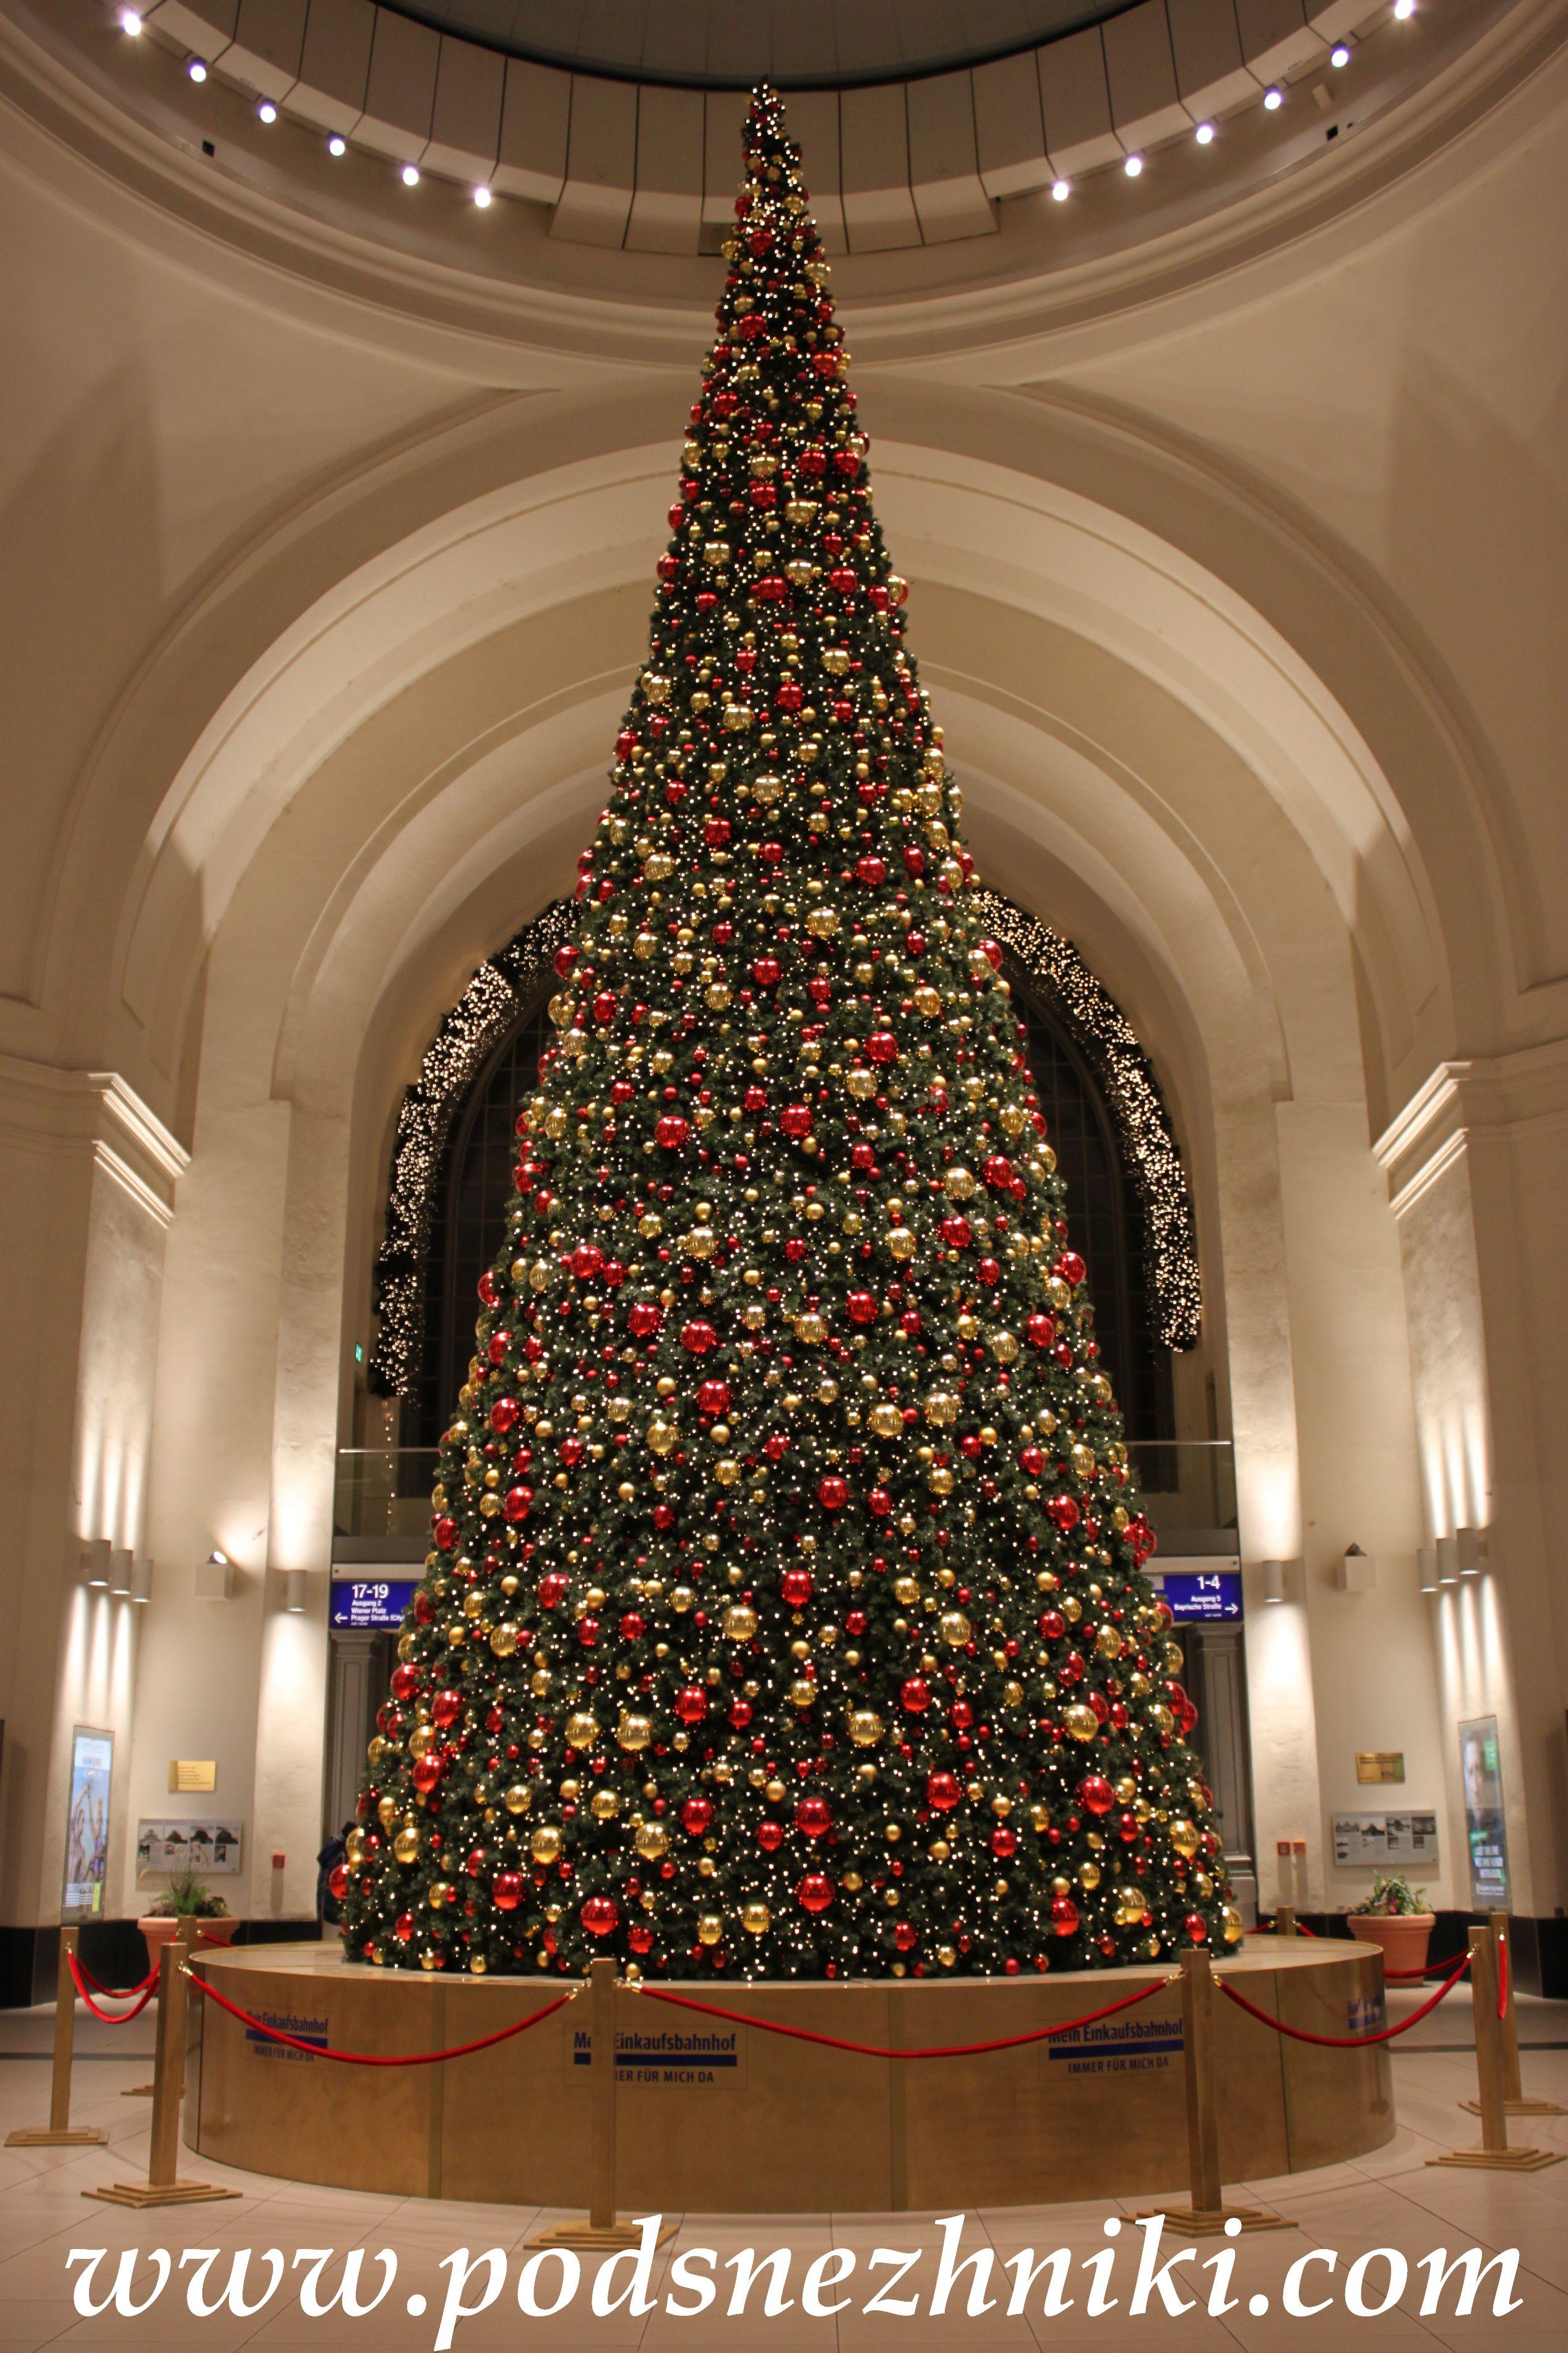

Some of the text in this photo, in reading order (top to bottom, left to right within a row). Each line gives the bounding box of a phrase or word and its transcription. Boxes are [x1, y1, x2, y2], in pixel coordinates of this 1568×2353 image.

[351, 1584, 389, 1599] 17-19
[262, 2012, 329, 2034] Einkaufsbahnhof
[1083, 2018, 1183, 2042] Einkaufsbahnhof
[253, 2045, 272, 2057] IMMER
[274, 2046, 285, 2058] FÜR
[286, 2049, 303, 2061] MICH
[1068, 2057, 1169, 2073] IMMER FÜR MICH DA
[637, 2068, 659, 2082] FÜR
[663, 2071, 694, 2083] MICH
[698, 2071, 714, 2083] DA
